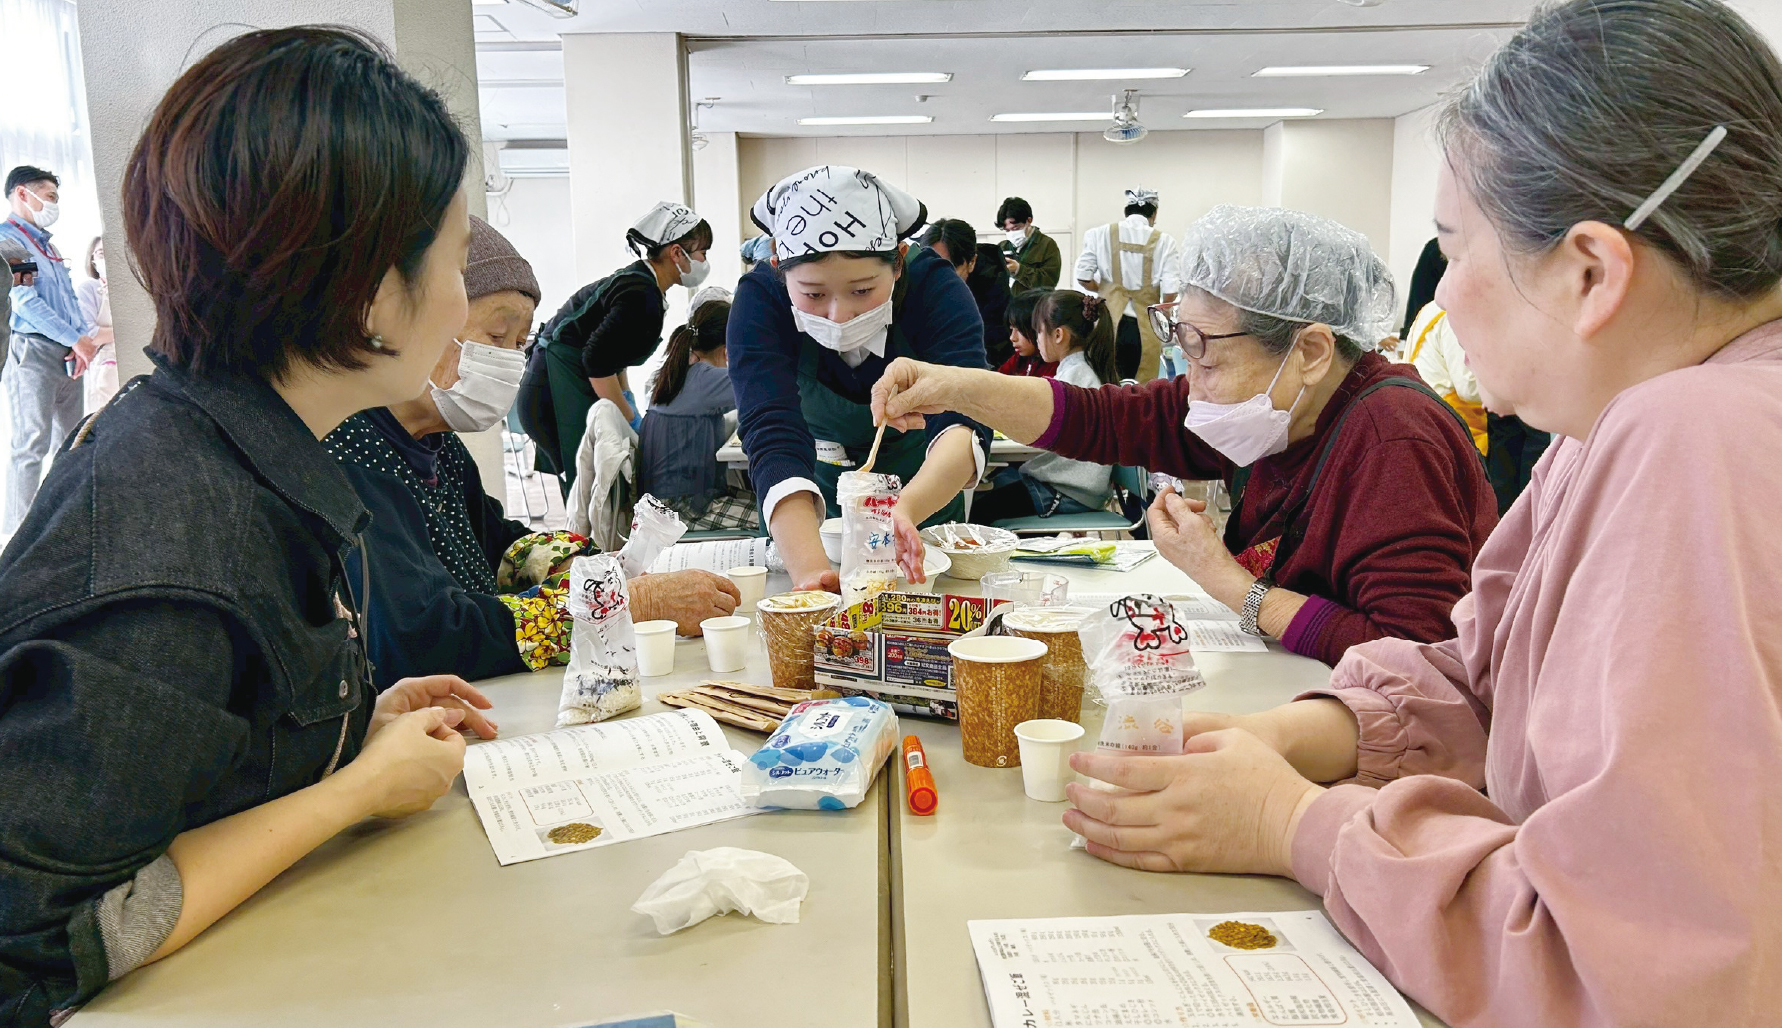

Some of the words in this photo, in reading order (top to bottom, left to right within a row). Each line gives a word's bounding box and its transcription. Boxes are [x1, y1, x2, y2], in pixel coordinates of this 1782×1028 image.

[786, 189, 837, 236] the
[948, 598, 982, 631] 20%
[794, 767, 844, 776] ピュアウォーター
